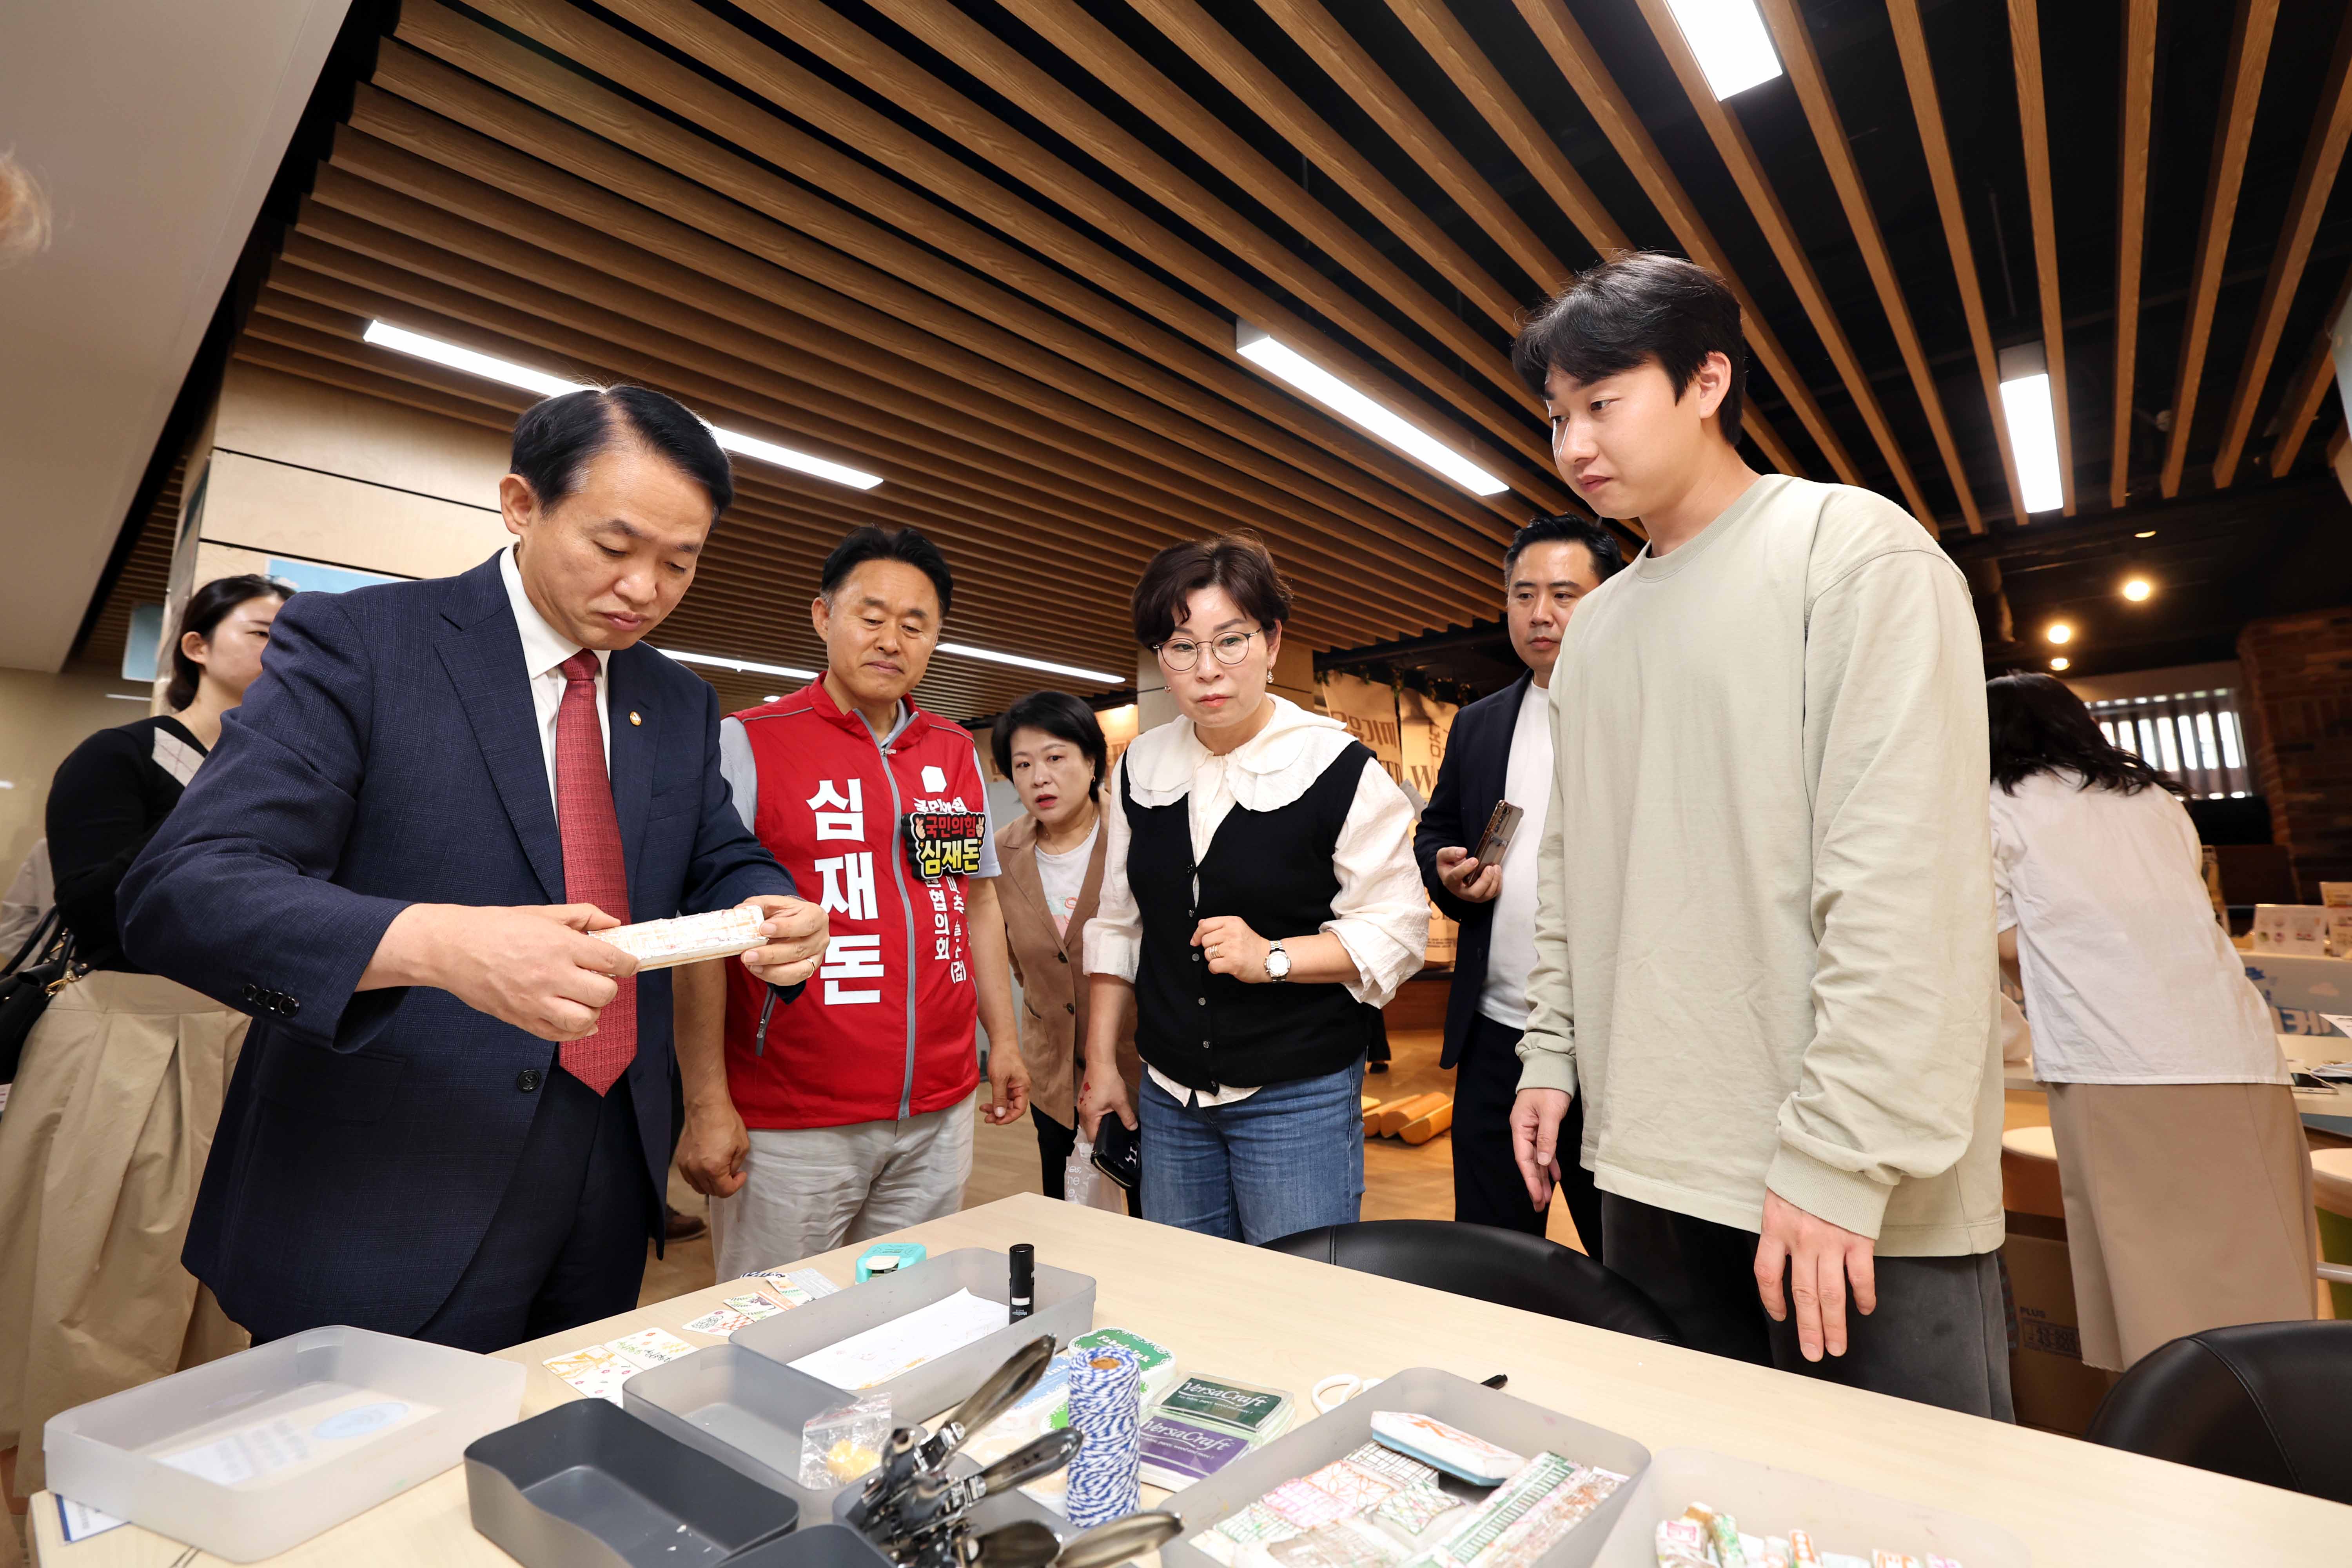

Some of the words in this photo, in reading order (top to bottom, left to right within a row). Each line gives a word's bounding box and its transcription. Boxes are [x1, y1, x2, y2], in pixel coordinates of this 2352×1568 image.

[926, 815, 976, 838] 국민의힘
[920, 838, 980, 875] 심재돈
[806, 779, 884, 1005] 심재돈
[1183, 1381, 1267, 1407] VersaCraft
[1141, 1420, 1231, 1451] VersaCraft
